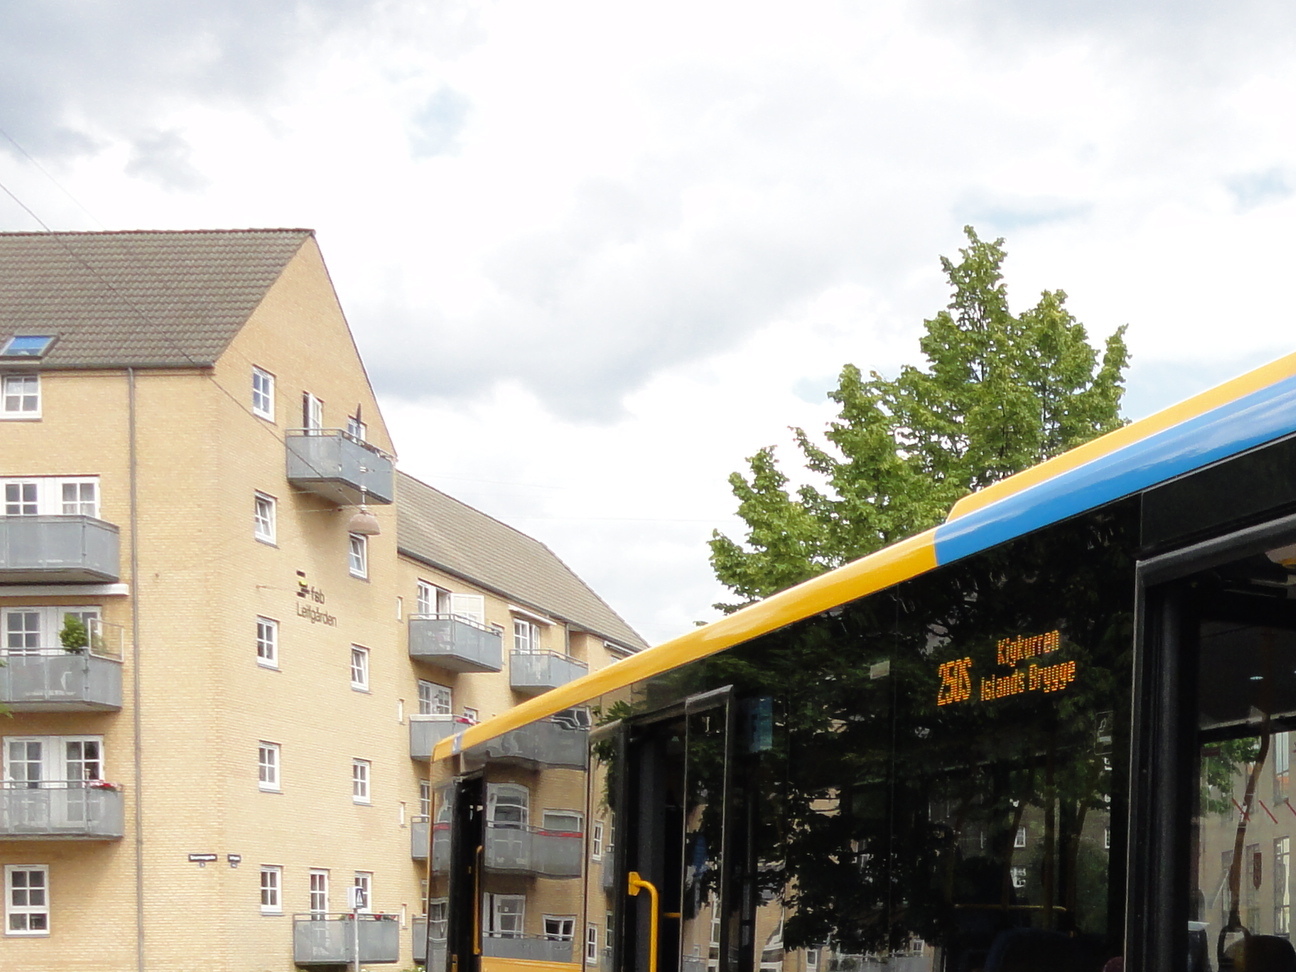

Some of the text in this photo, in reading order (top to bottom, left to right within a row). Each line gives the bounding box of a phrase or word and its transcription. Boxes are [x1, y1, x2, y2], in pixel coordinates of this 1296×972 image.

[997, 629, 1060, 668] Kigkurren
[936, 656, 973, 706] 250S
[980, 660, 1076, 702] Islands Brygge
